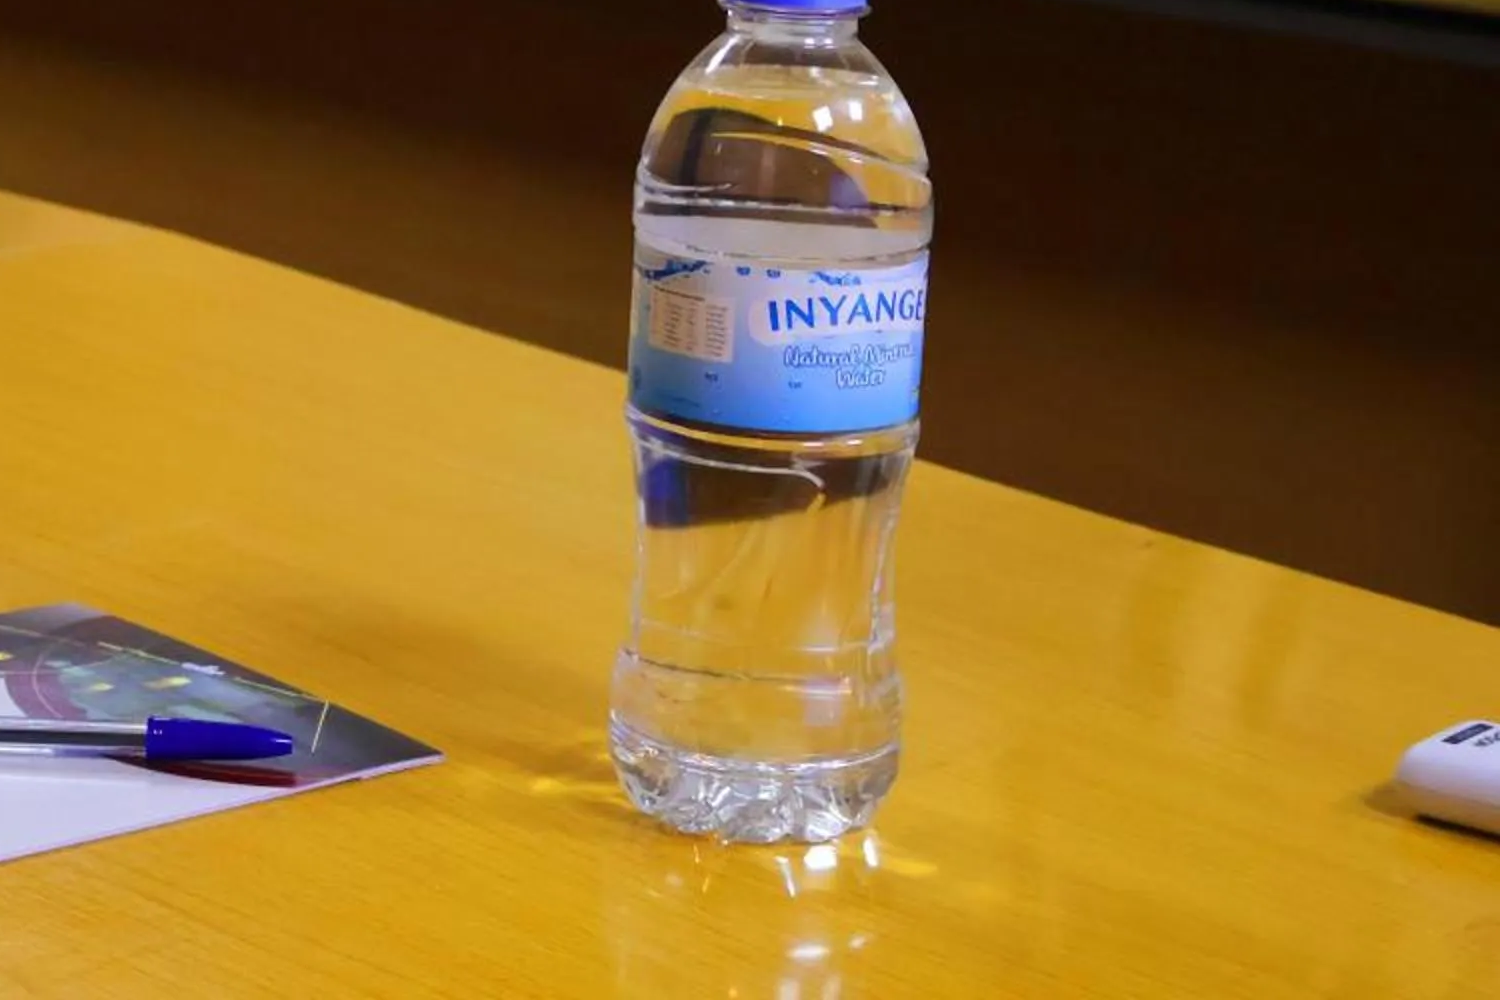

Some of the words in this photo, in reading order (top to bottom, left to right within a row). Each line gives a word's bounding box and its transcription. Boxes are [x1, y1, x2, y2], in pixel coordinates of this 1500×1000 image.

[768, 289, 924, 332] INYANGE
[783, 343, 862, 368] Natural
[863, 342, 917, 367] Miner
[836, 366, 886, 389] Water
